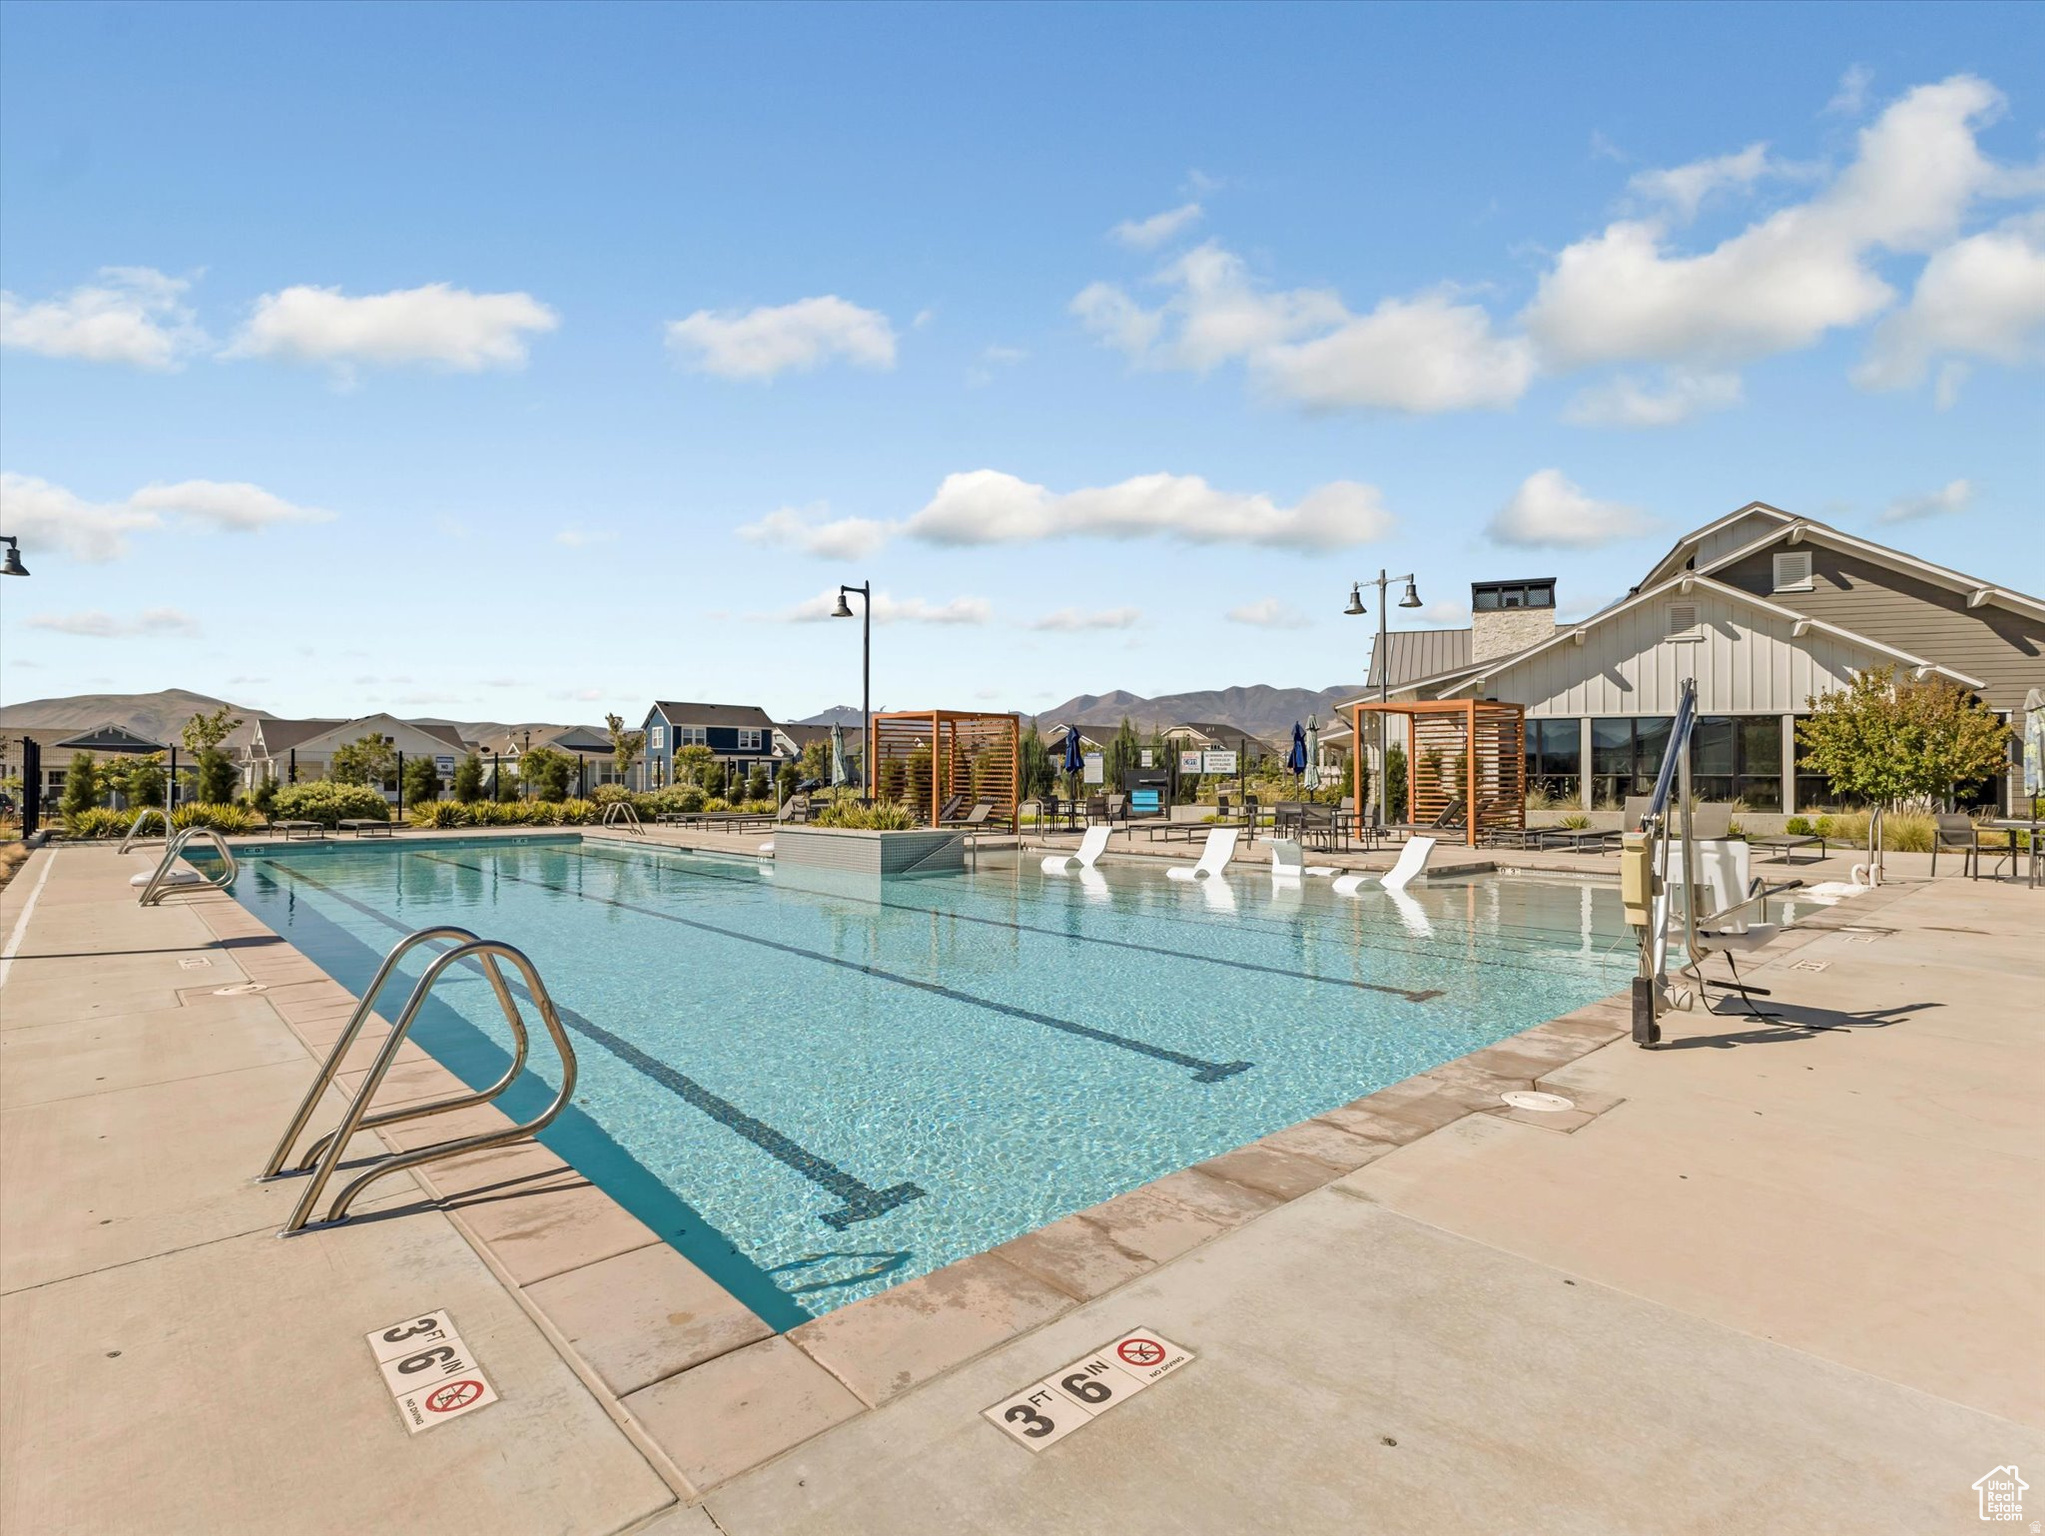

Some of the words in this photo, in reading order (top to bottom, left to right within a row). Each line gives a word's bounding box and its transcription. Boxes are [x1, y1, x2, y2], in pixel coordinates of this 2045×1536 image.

[383, 1318, 437, 1343] 3
[424, 1329, 446, 1342] FT
[397, 1346, 455, 1375] 6
[441, 1359, 465, 1374] IN
[1084, 1360, 1110, 1376] IN
[1149, 1369, 1162, 1379] NO
[1162, 1356, 1185, 1372] DIVING
[1028, 1390, 1053, 1408] FT
[1061, 1373, 1112, 1404] 6
[407, 1398, 416, 1407] NO
[409, 1406, 424, 1426] DIVING
[1004, 1404, 1055, 1438] 3
